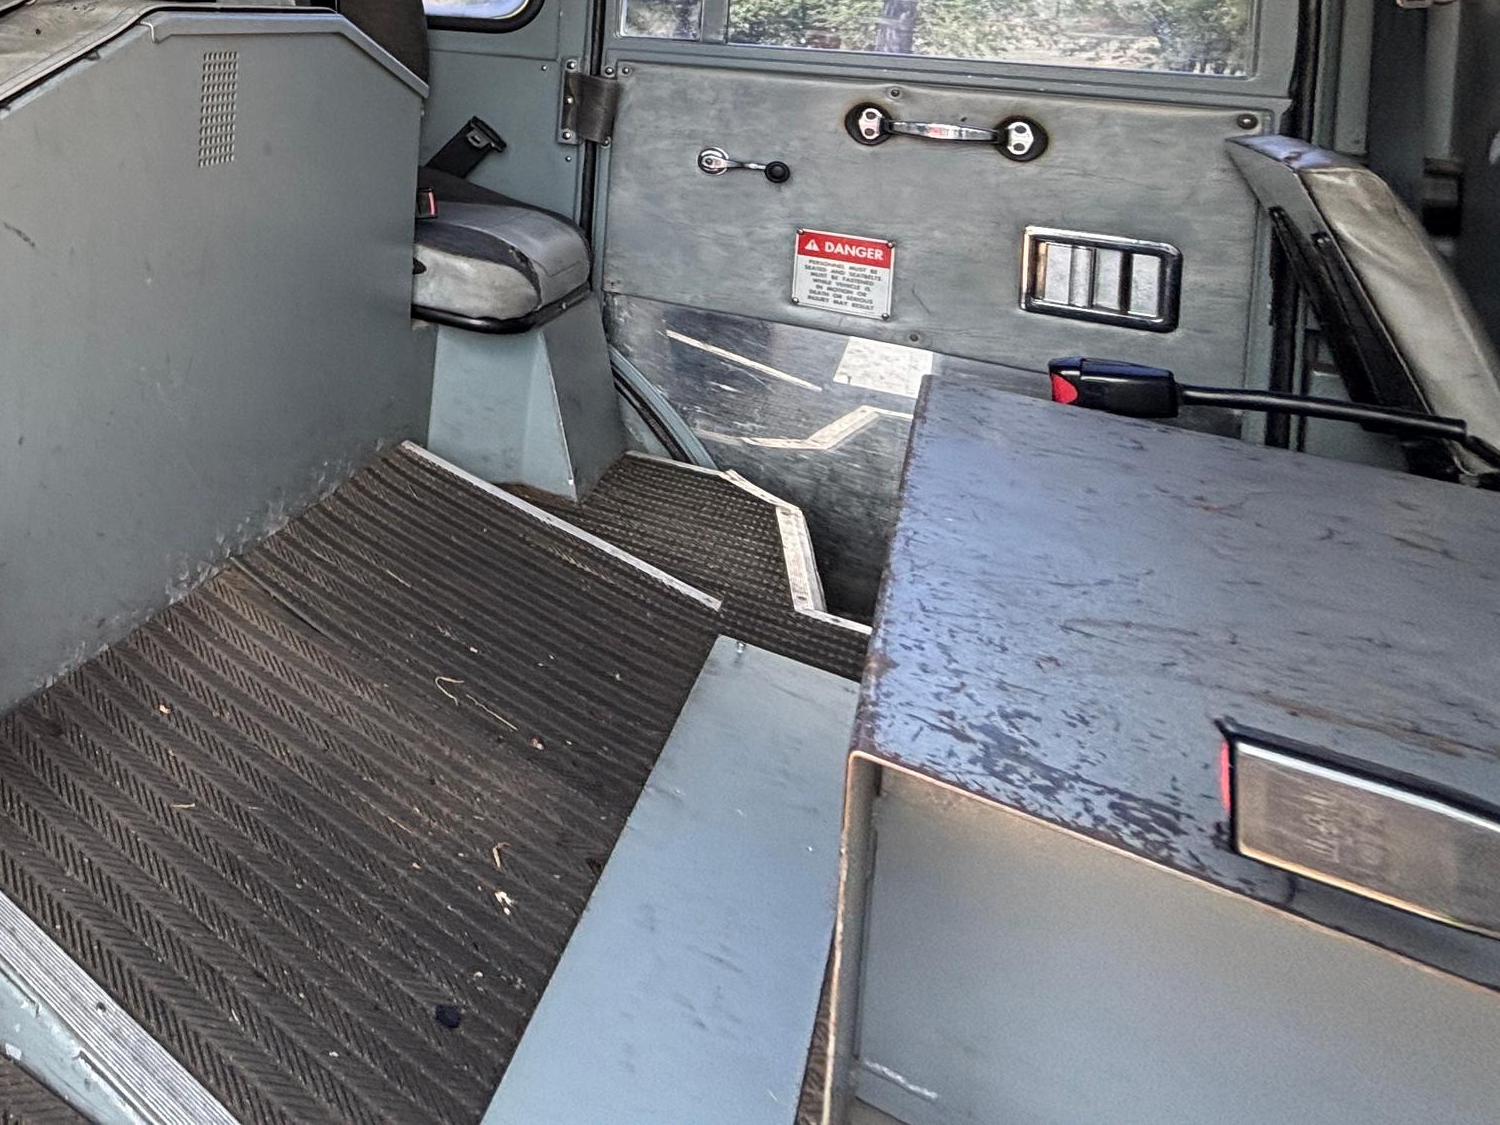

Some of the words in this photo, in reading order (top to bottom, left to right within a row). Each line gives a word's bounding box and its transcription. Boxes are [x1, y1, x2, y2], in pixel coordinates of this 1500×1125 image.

[824, 241, 884, 261] DANGER
[804, 264, 827, 272] SEATED
[808, 259, 845, 269] PERSONNEL
[835, 281, 860, 290] VEHICLE
[842, 277, 875, 286] FASTENED
[826, 286, 854, 295] MOTION
[809, 289, 830, 297] DEATH
[846, 295, 874, 305] SERIOUS
[851, 302, 875, 310] RESULT
